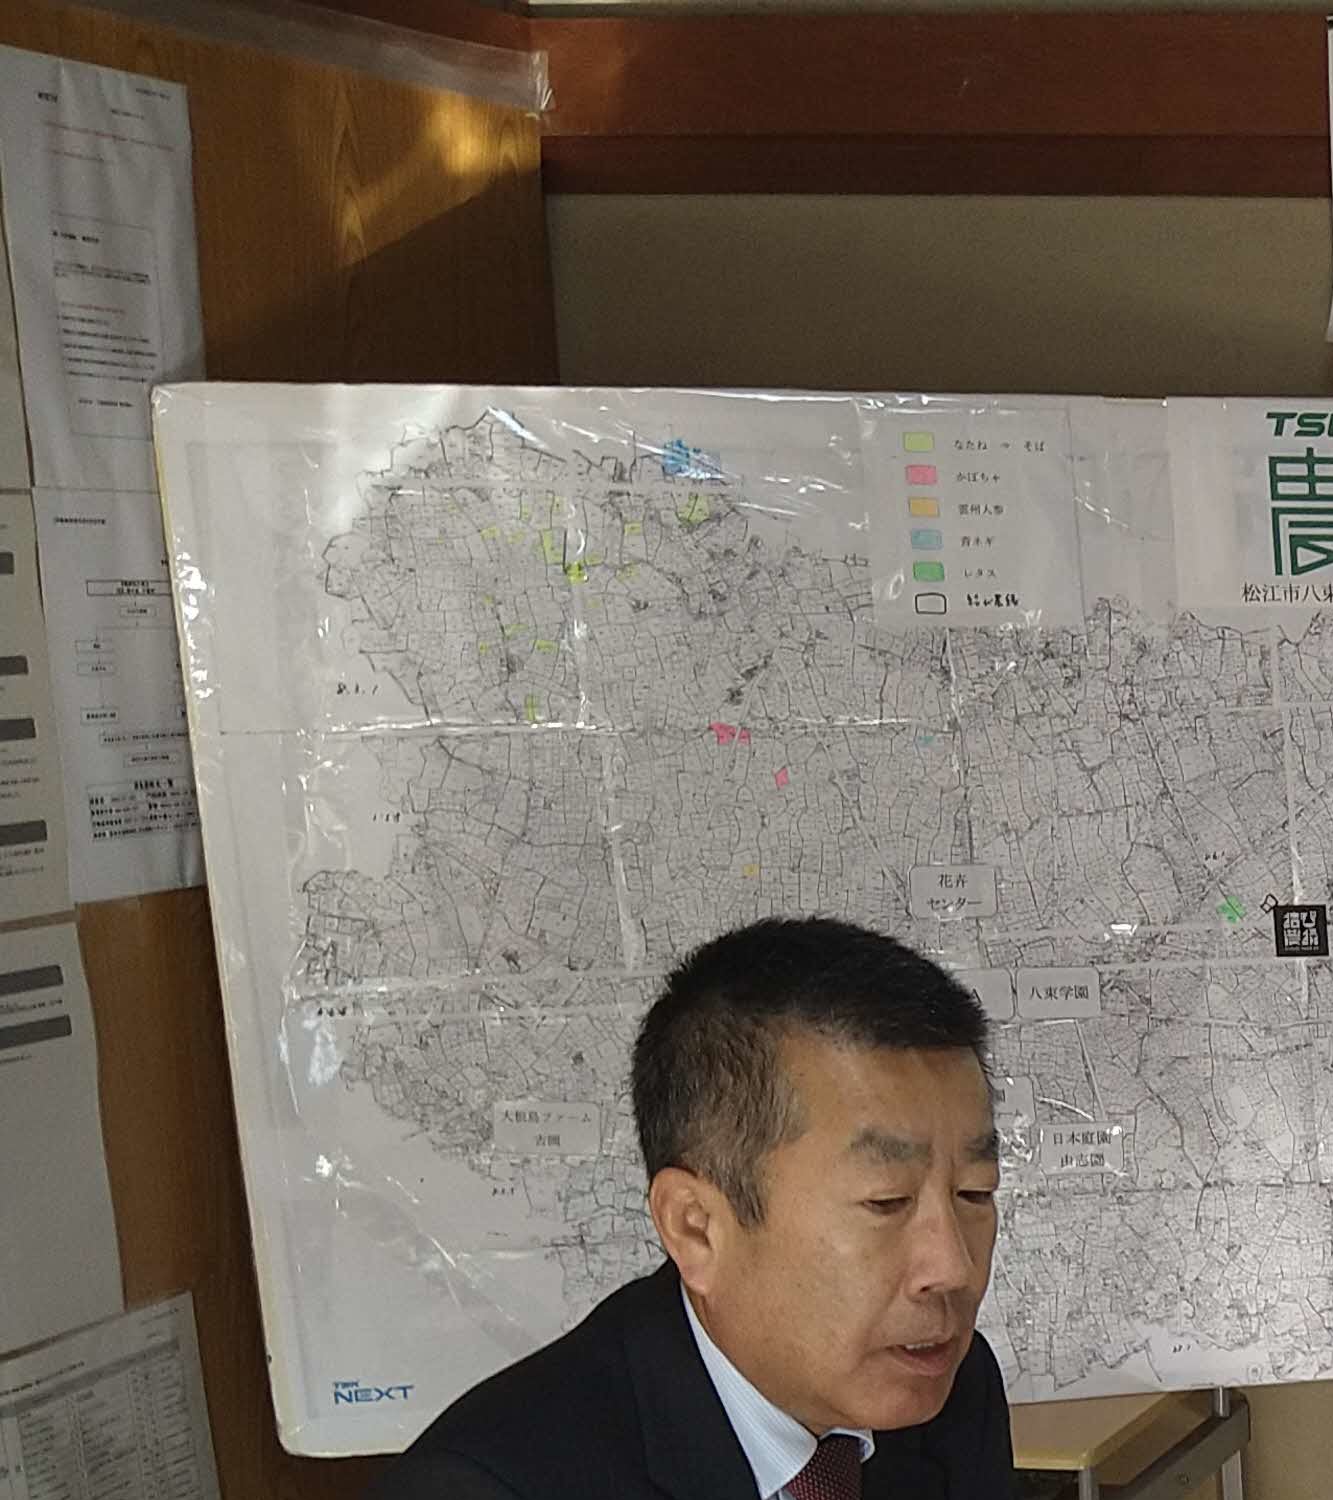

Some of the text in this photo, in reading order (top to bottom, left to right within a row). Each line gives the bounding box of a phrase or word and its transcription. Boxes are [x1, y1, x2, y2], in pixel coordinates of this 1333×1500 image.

[954, 440, 1046, 452] なたね そば
[956, 471, 1001, 483] かぼちゃ
[939, 874, 968, 889] 花卉
[928, 898, 983, 912] センター
[334, 1385, 414, 1405] NEXT
